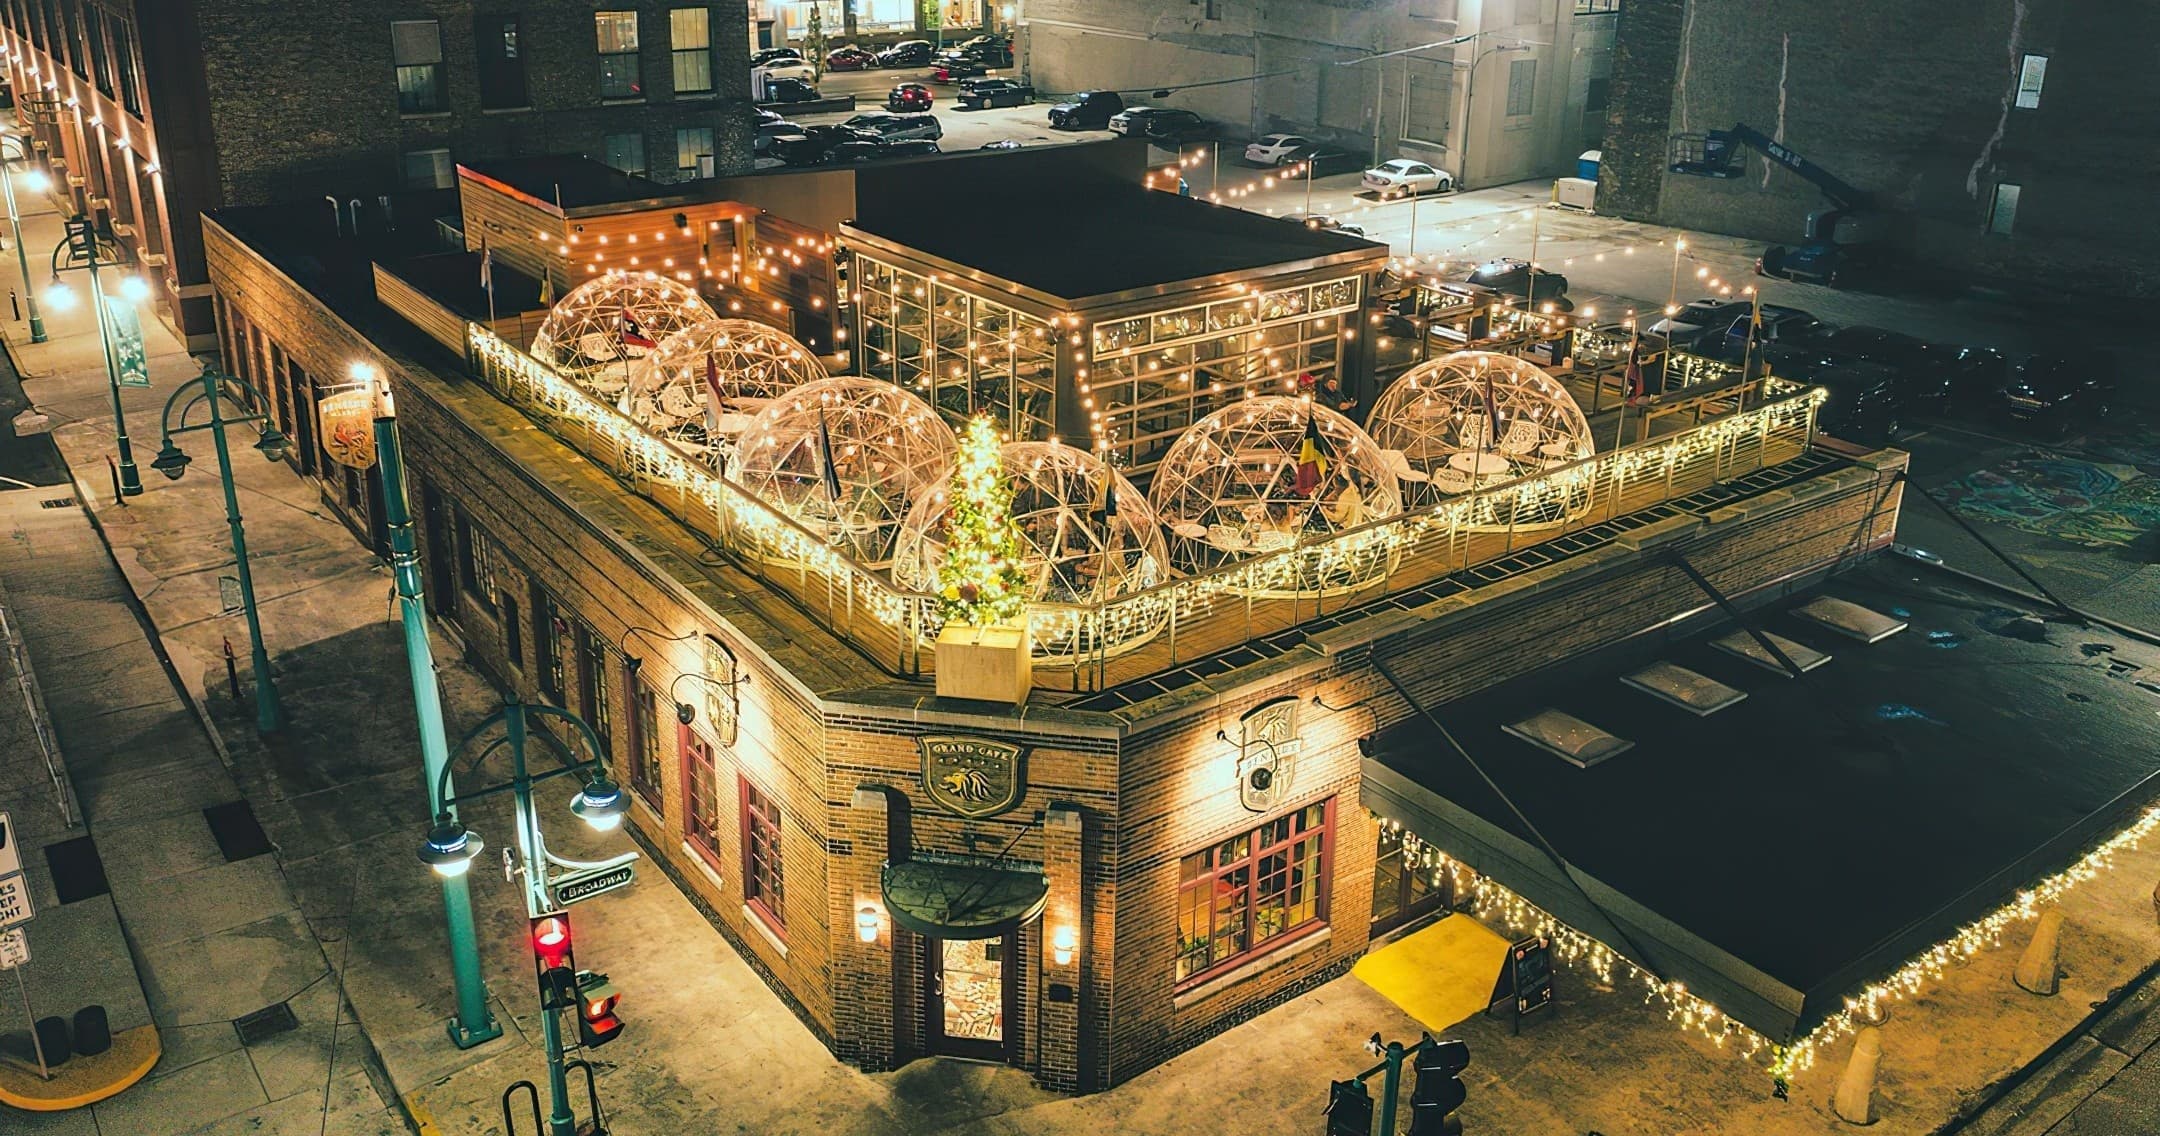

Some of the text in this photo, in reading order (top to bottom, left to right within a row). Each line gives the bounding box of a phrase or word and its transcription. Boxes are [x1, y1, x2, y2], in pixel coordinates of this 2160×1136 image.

[932, 743, 974, 754] GRAND
[568, 871, 629, 898] BROADWAY
[0, 905, 21, 920] GHT
